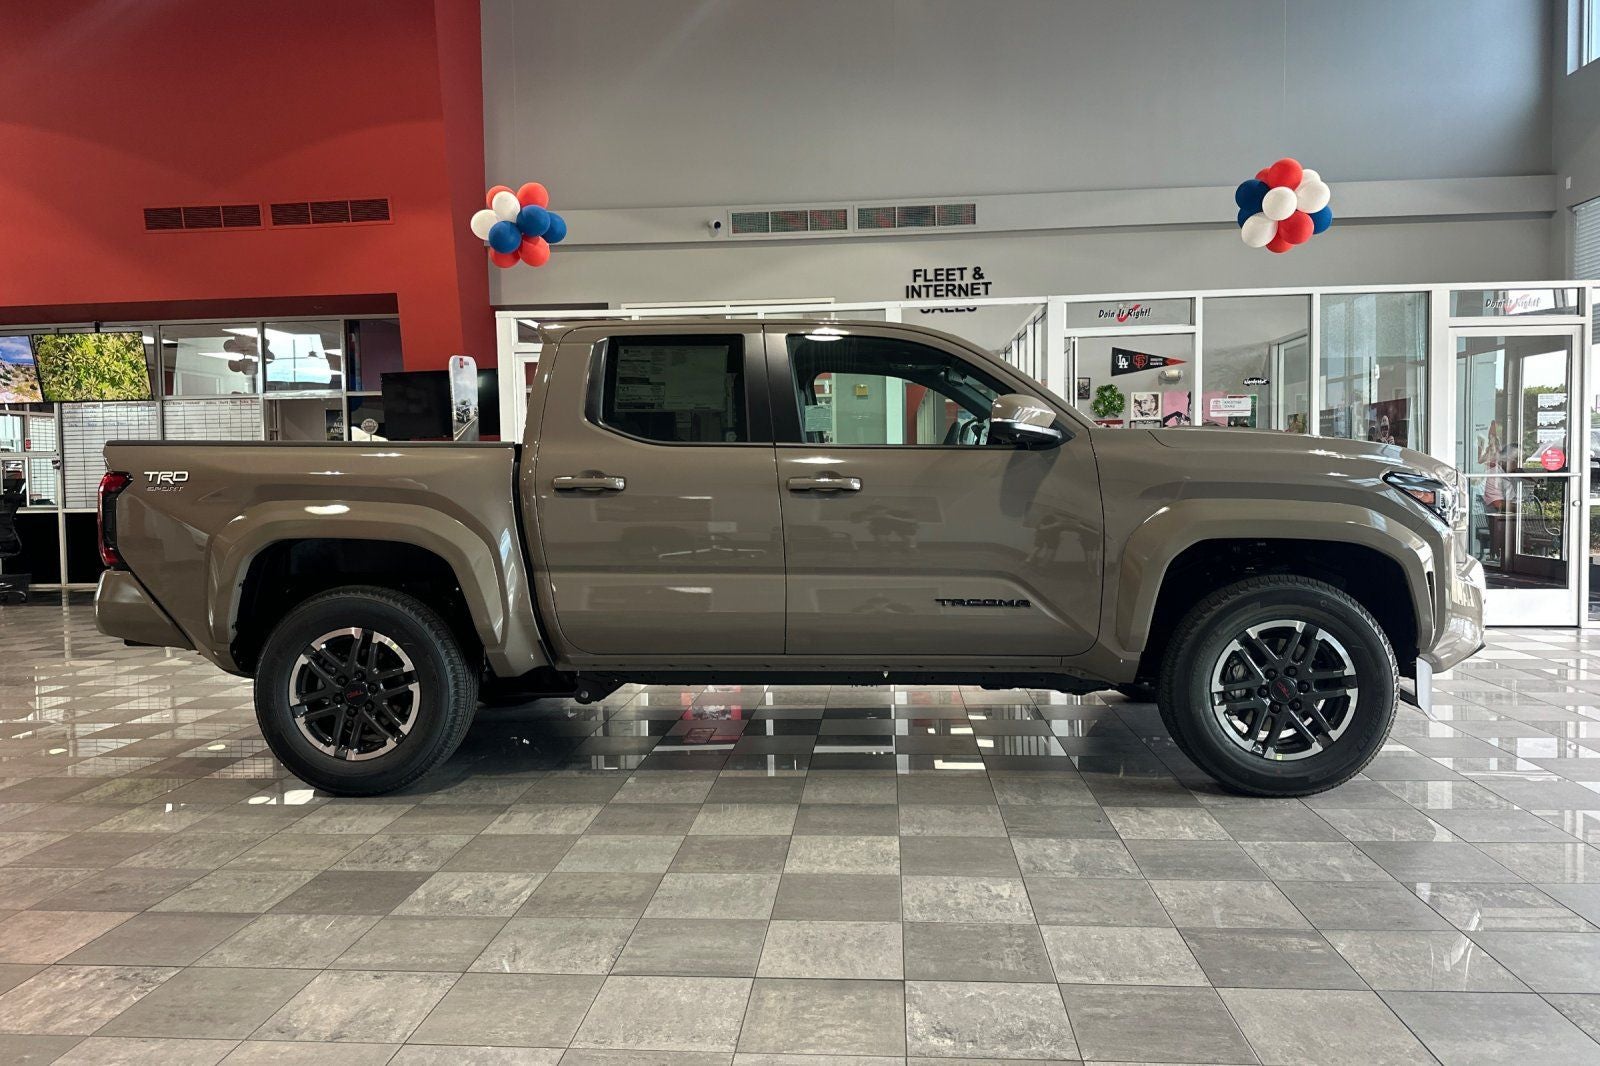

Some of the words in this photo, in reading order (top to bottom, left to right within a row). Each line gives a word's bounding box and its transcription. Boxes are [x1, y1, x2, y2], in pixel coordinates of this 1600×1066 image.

[912, 267, 968, 283] FLEET
[972, 266, 985, 281] &
[905, 281, 993, 299] INTERNET
[1126, 307, 1152, 320] Right!
[143, 471, 189, 485] TRD
[935, 598, 1031, 608] TACOMA
